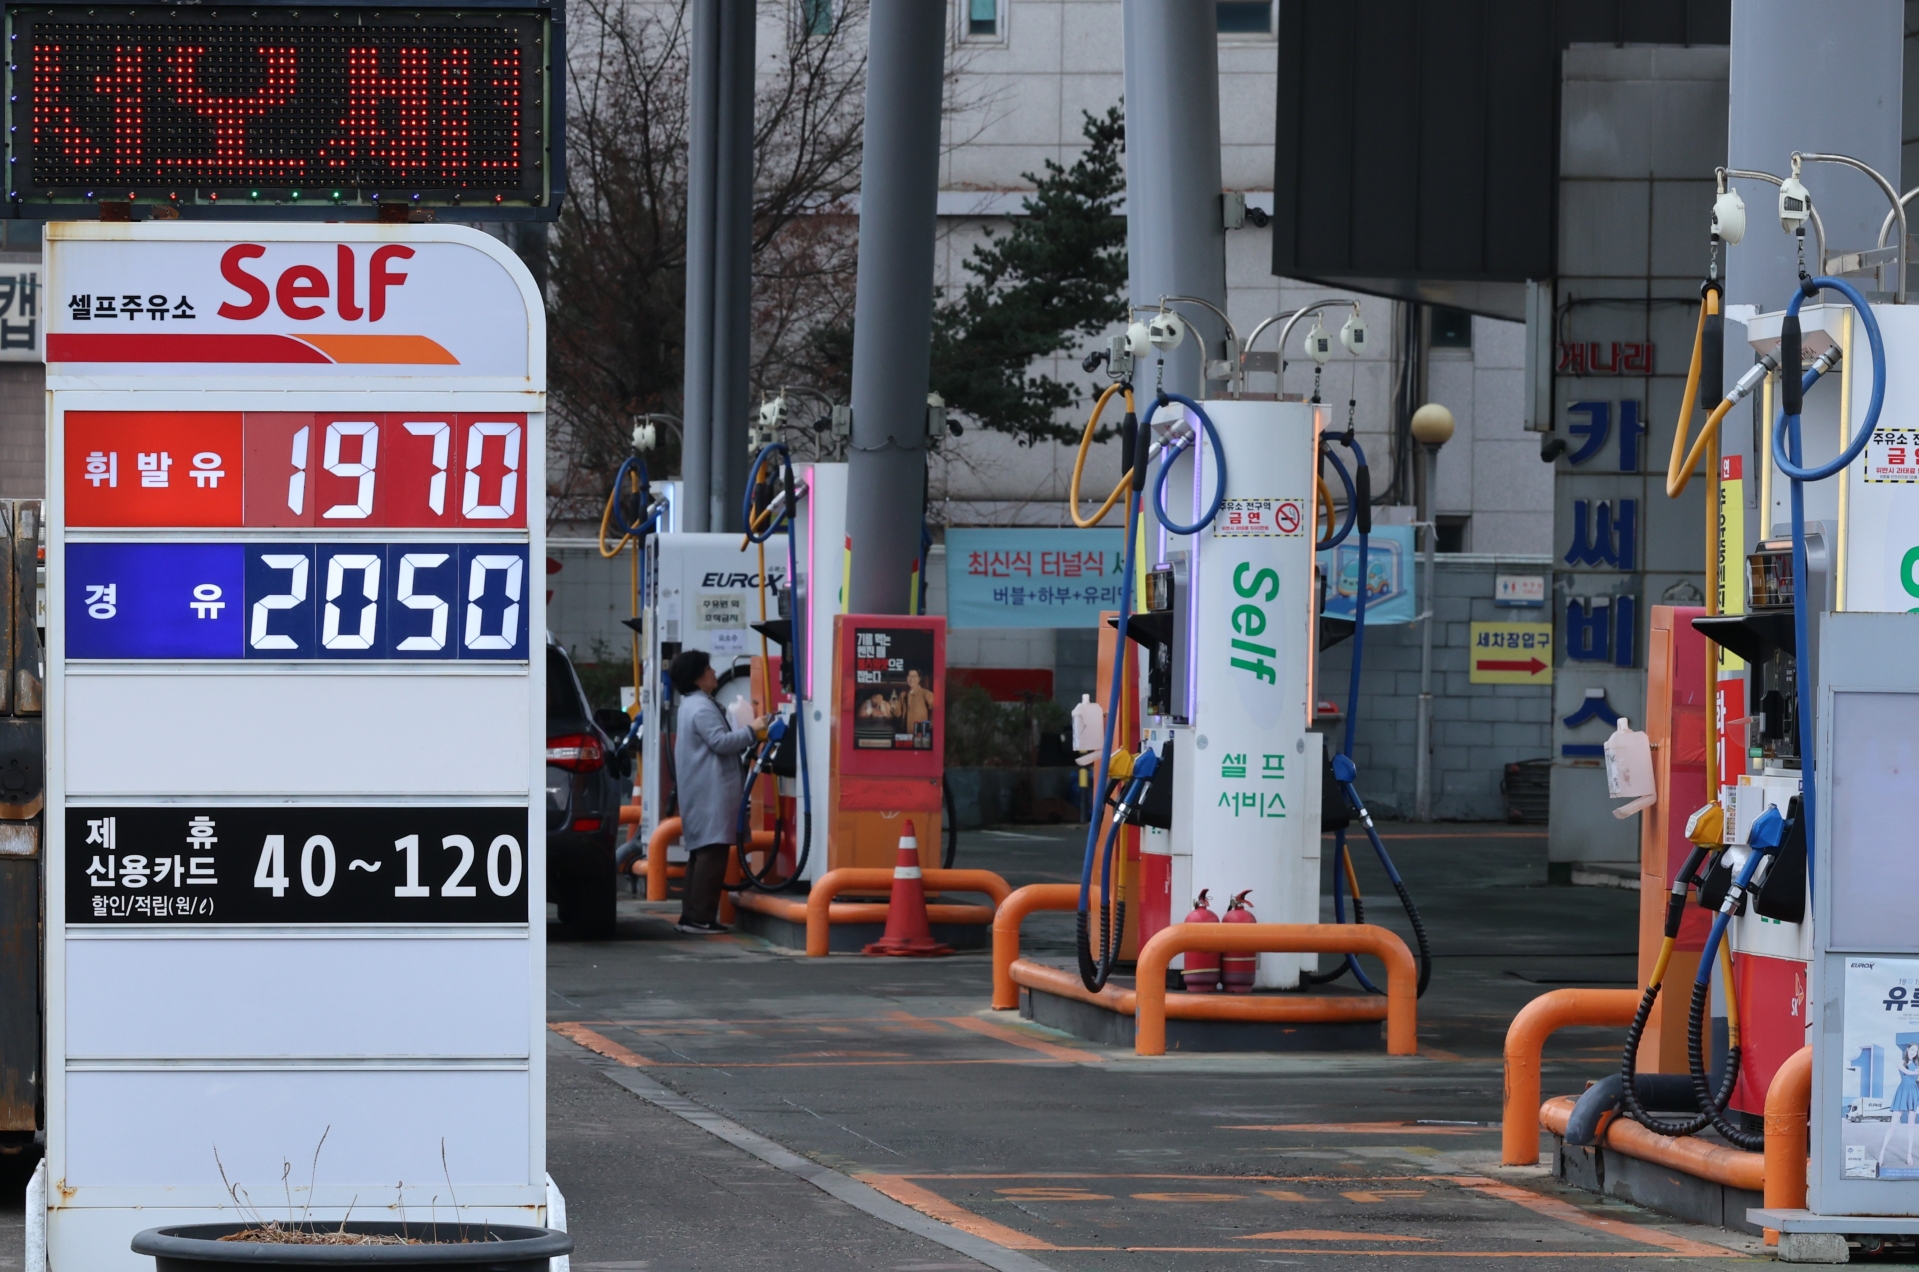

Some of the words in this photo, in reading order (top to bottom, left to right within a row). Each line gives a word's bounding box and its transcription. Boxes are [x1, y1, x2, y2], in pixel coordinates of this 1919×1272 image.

[216, 243, 416, 323] Self
[67, 294, 196, 321] 셀프주유소
[1873, 432, 1908, 446] 주유소
[287, 421, 522, 520] 1970
[1876, 467, 1895, 475] 위반시
[1246, 502, 1271, 511] 전구역
[968, 550, 1032, 577] 최신식
[1041, 550, 1104, 578] 터널식
[249, 552, 524, 651] 2050
[1229, 561, 1280, 687] Self
[1476, 630, 1550, 650] 세차장입구
[1221, 752, 1285, 780] 셀프
[1218, 790, 1286, 819] 서비스
[85, 854, 218, 889] 신용카드
[1850, 962, 1875, 970] EUROX
